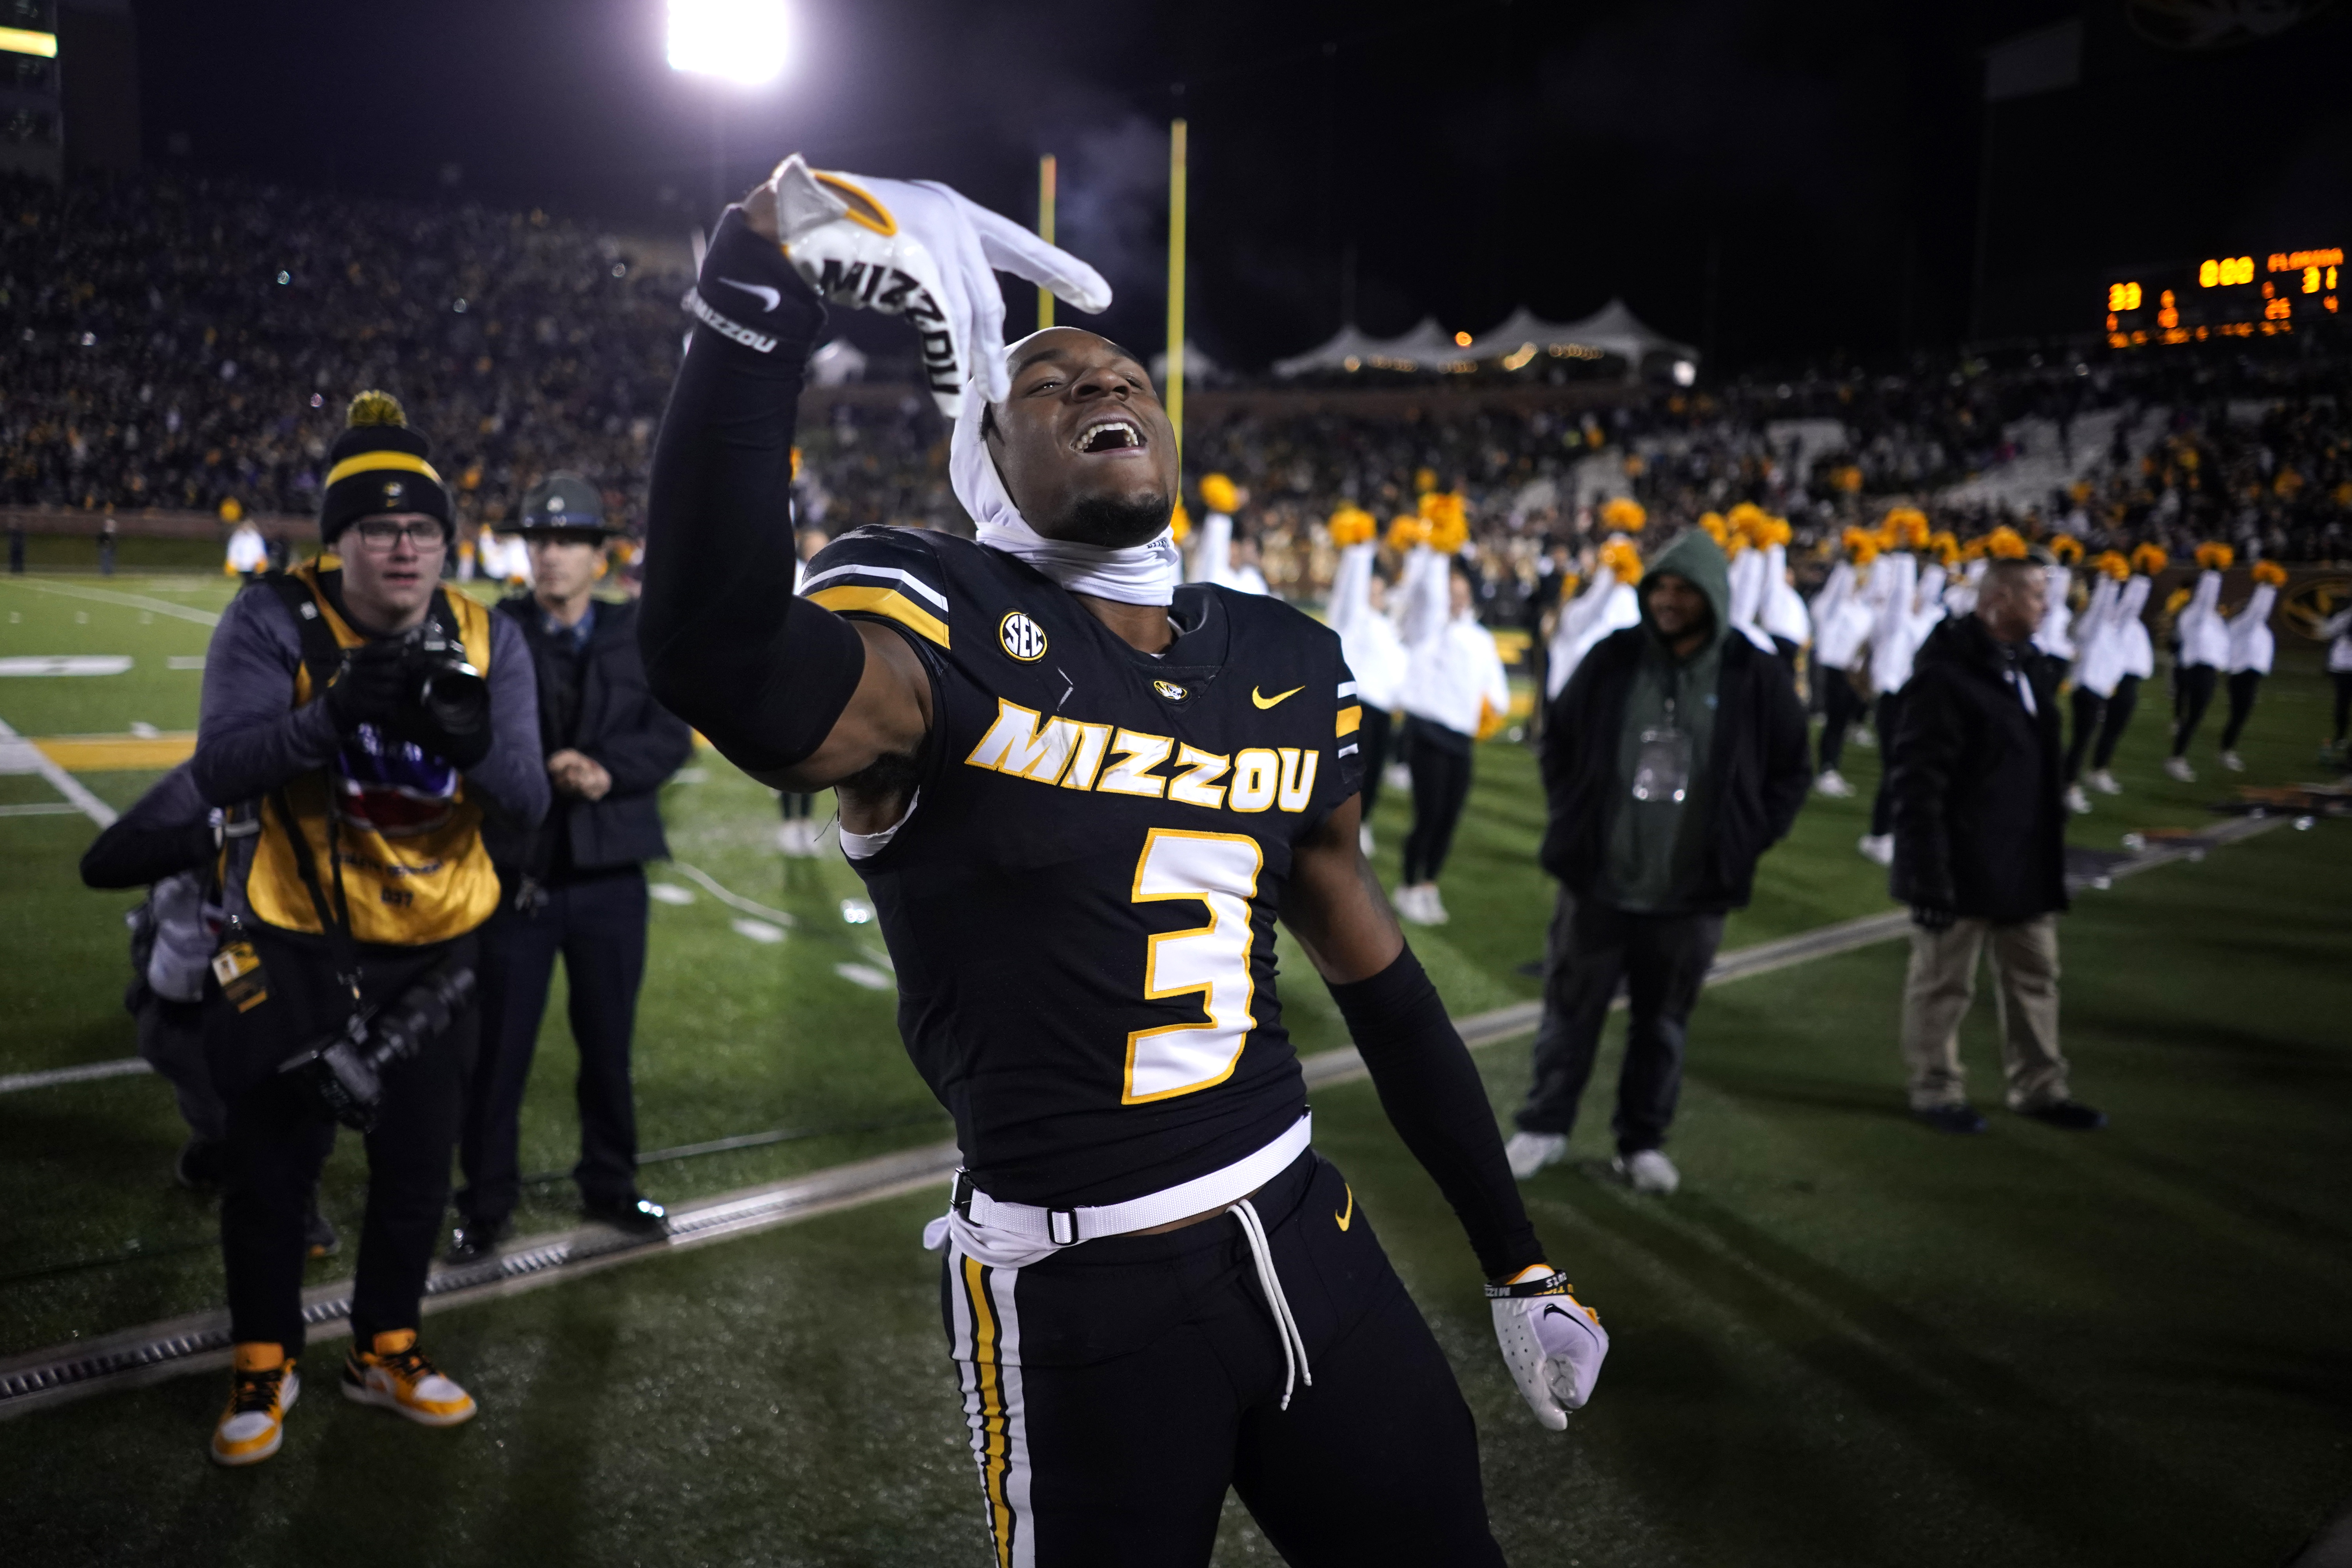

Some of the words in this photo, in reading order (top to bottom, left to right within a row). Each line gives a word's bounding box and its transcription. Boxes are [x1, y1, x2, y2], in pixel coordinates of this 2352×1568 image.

[819, 259, 960, 394] MIZZOU
[1004, 615, 1044, 657] SEC
[964, 697, 1319, 813] MIZZOU
[1121, 828, 1263, 1105] 3
